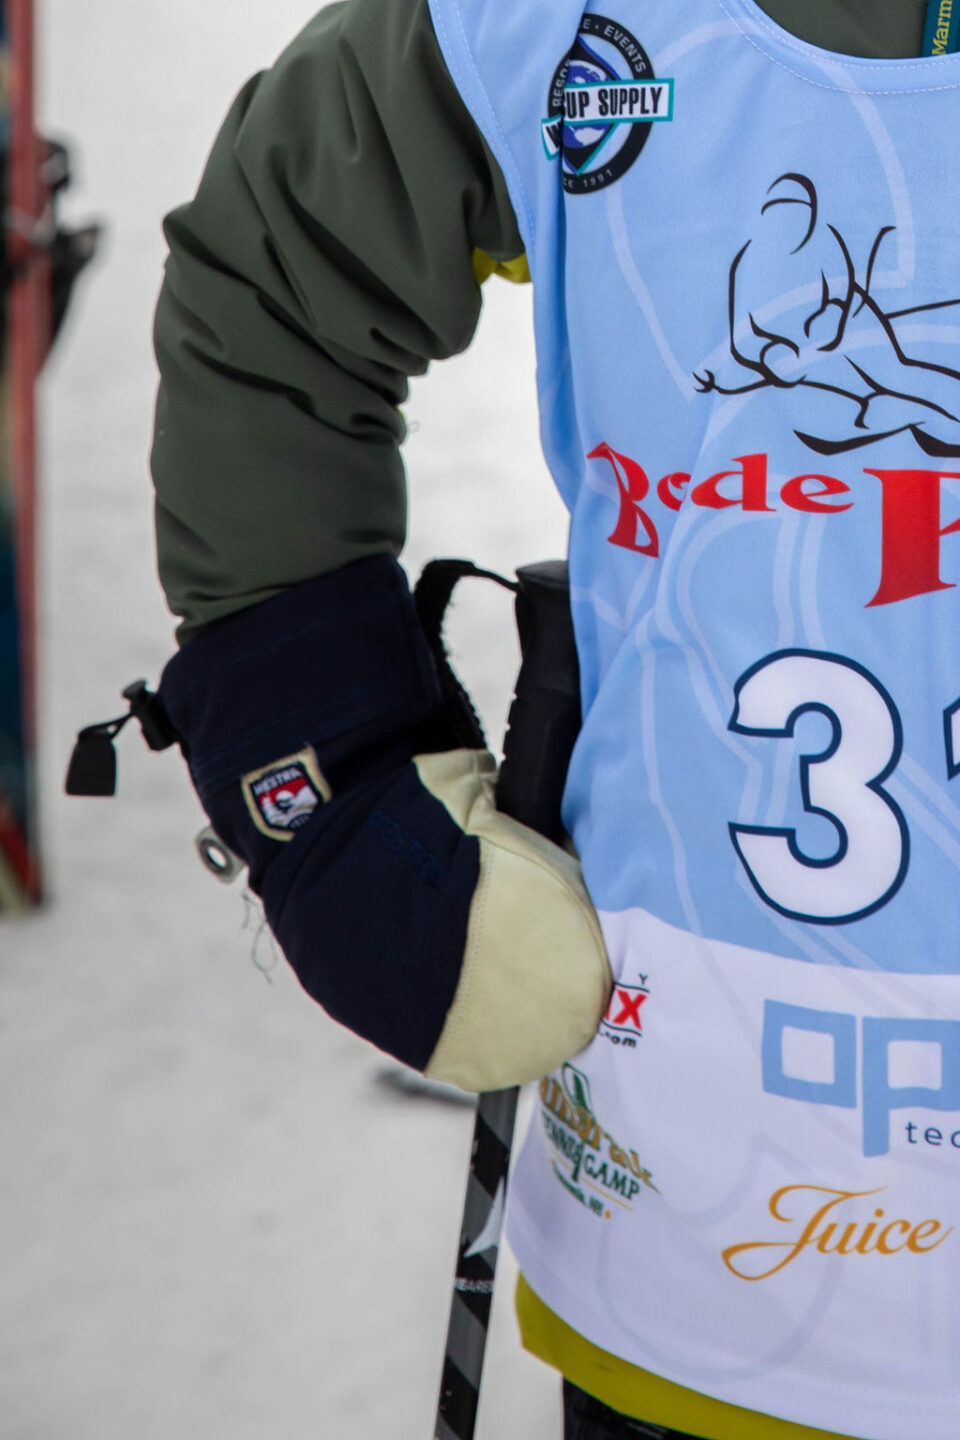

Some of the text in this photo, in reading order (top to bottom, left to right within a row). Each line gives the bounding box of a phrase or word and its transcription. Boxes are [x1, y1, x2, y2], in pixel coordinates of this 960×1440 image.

[604, 24, 646, 74] EVENTS
[563, 86, 663, 120] UP SUPPLY
[583, 169, 613, 188] 1991
[584, 1153, 641, 1201] CAMP
[721, 1184, 954, 1282] Juice
